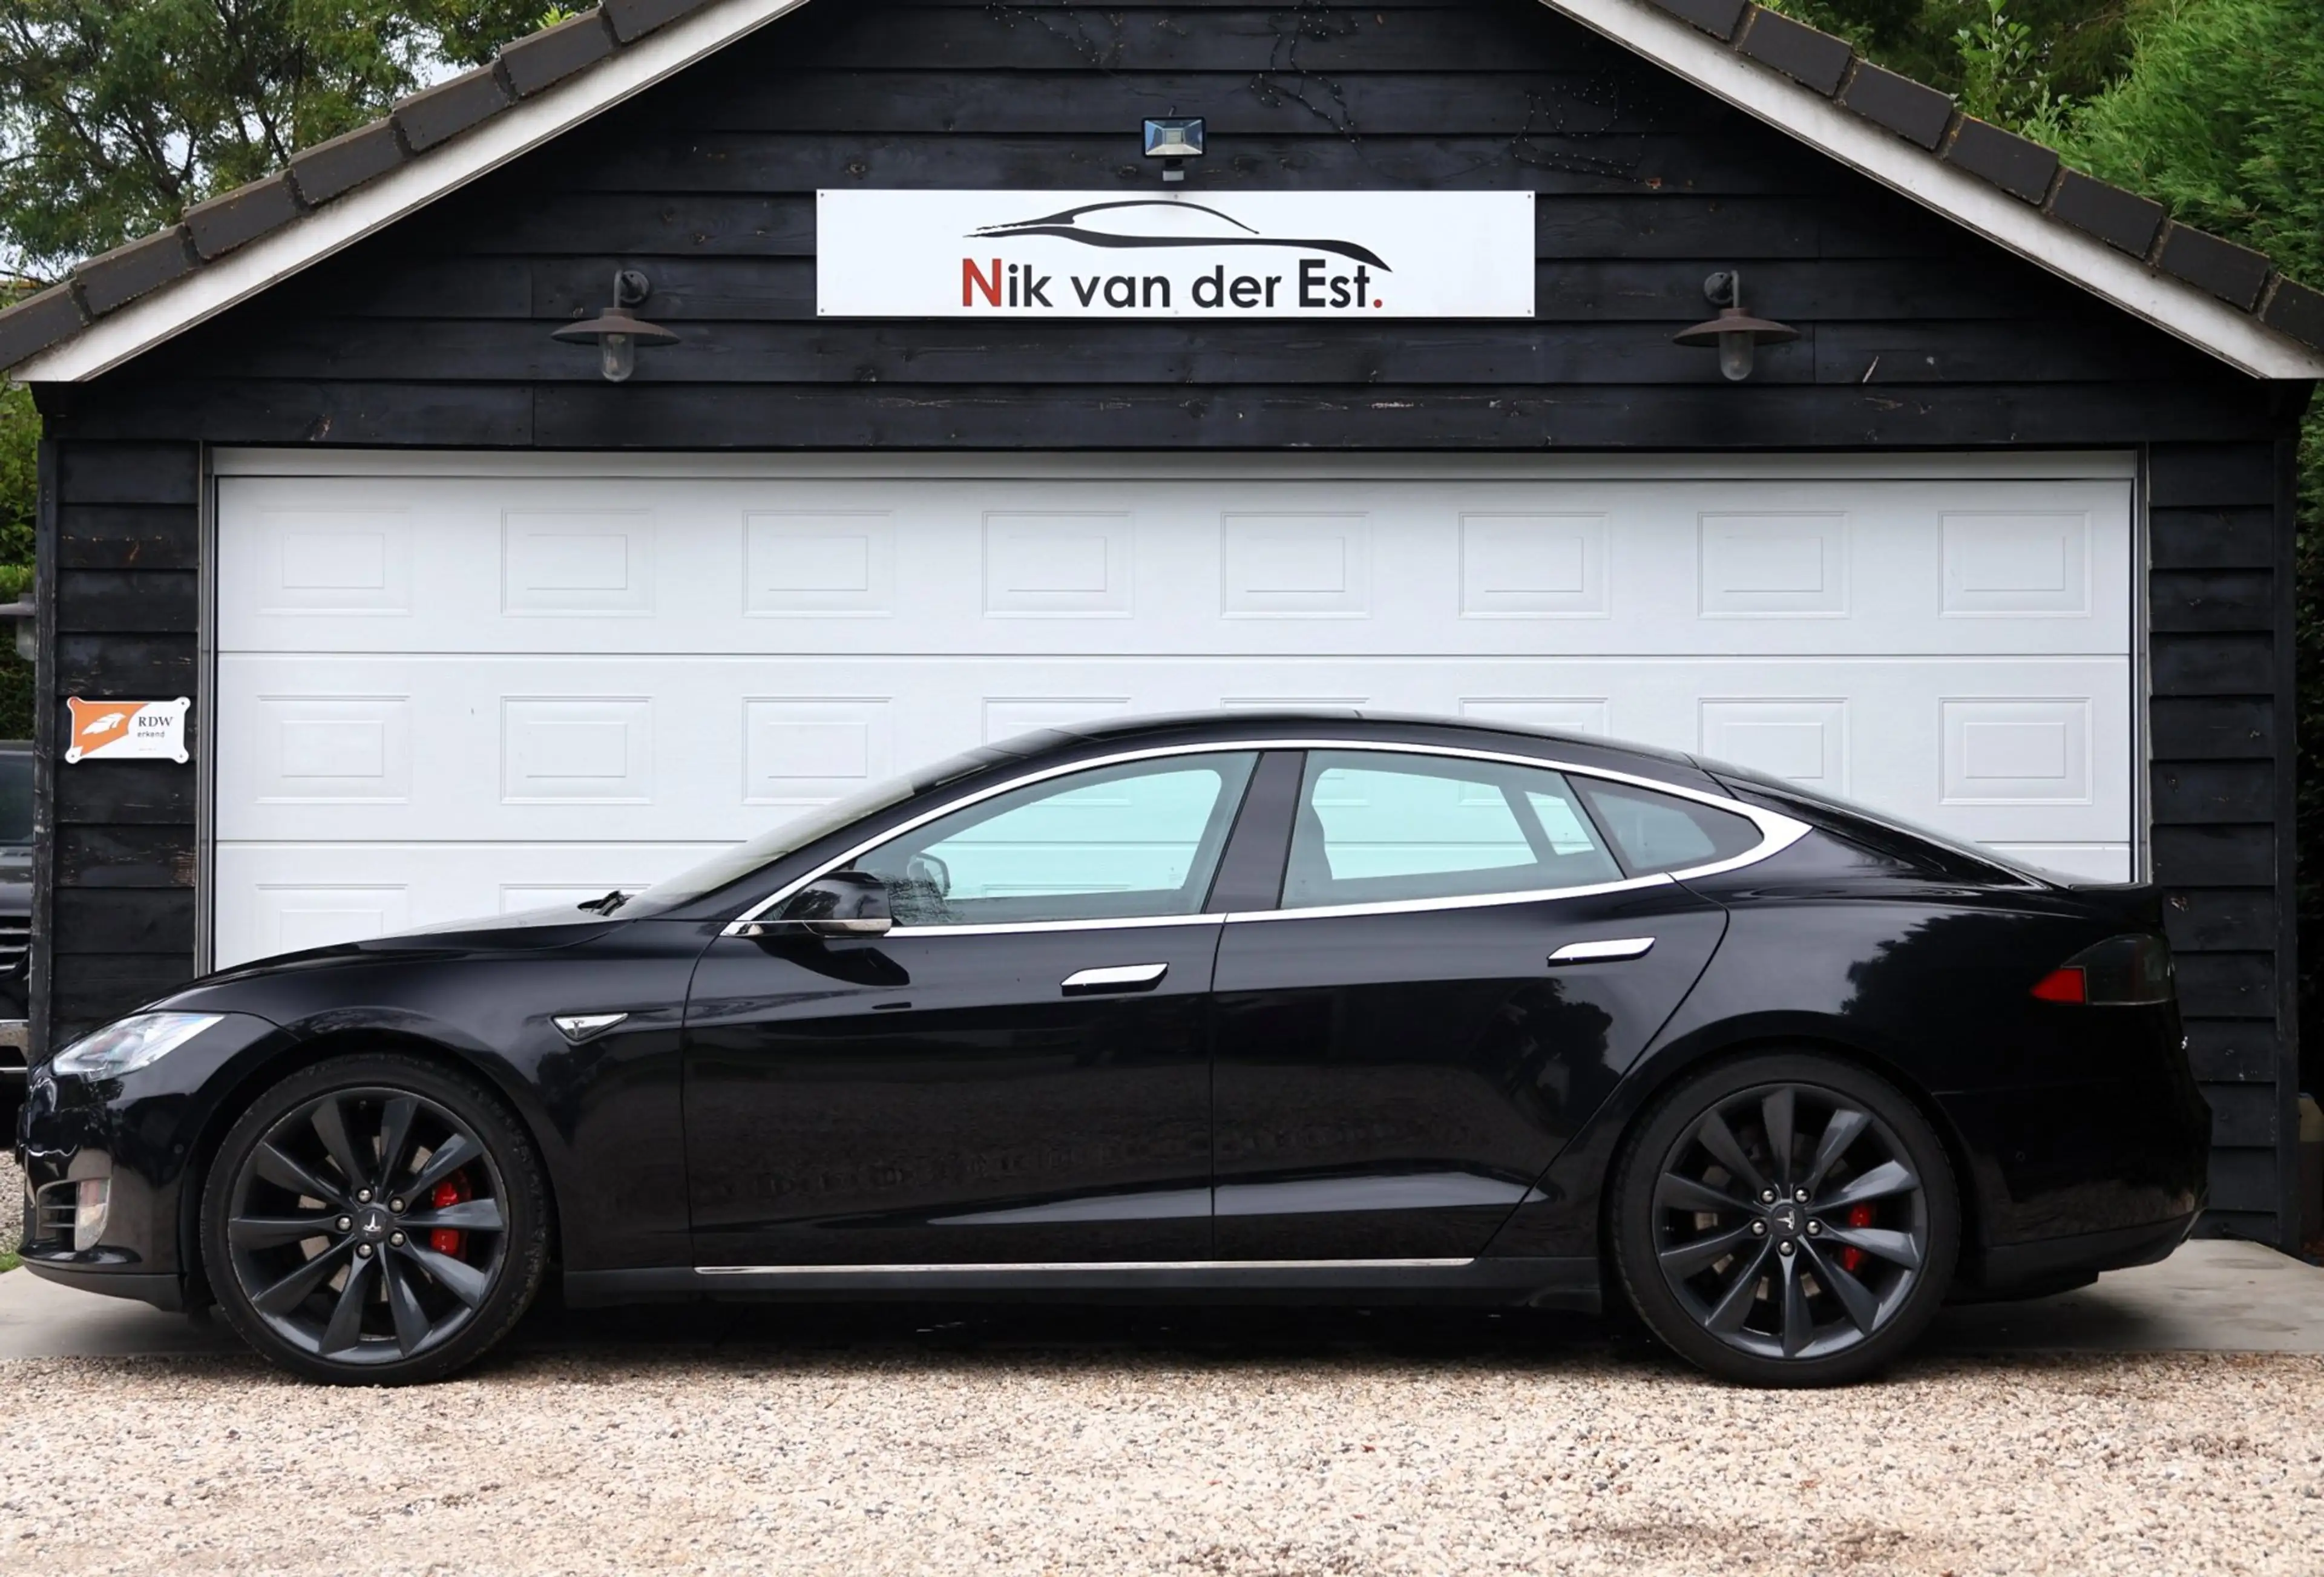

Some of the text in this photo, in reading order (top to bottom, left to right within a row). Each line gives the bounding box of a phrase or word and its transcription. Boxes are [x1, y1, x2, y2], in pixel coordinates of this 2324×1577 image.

[962, 258, 1382, 309] Nik van der Est.
[139, 716, 174, 727] RDW
